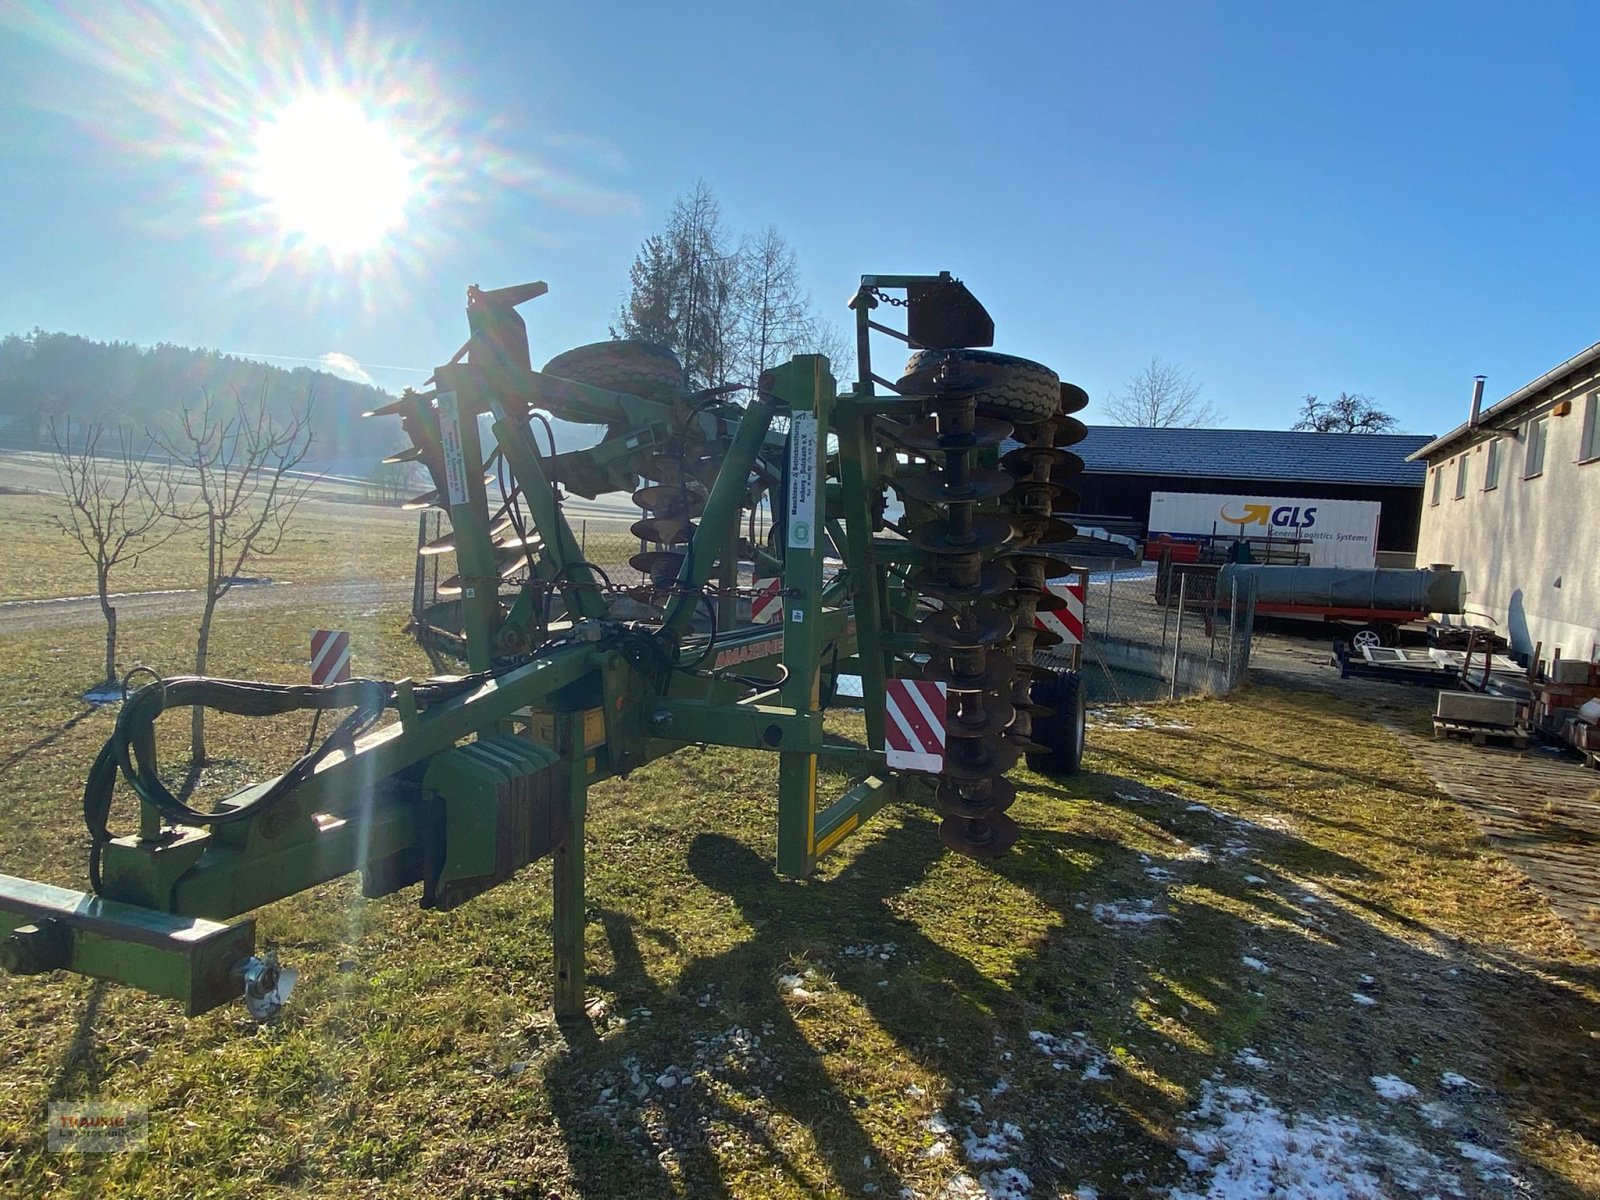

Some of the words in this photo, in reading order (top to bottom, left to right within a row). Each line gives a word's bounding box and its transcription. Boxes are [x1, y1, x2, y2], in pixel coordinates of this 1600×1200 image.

[1271, 506, 1317, 528] GLS
[1270, 528, 1298, 538] Genera
[1336, 532, 1368, 542] Systems
[714, 638, 784, 669] AMAZONE
